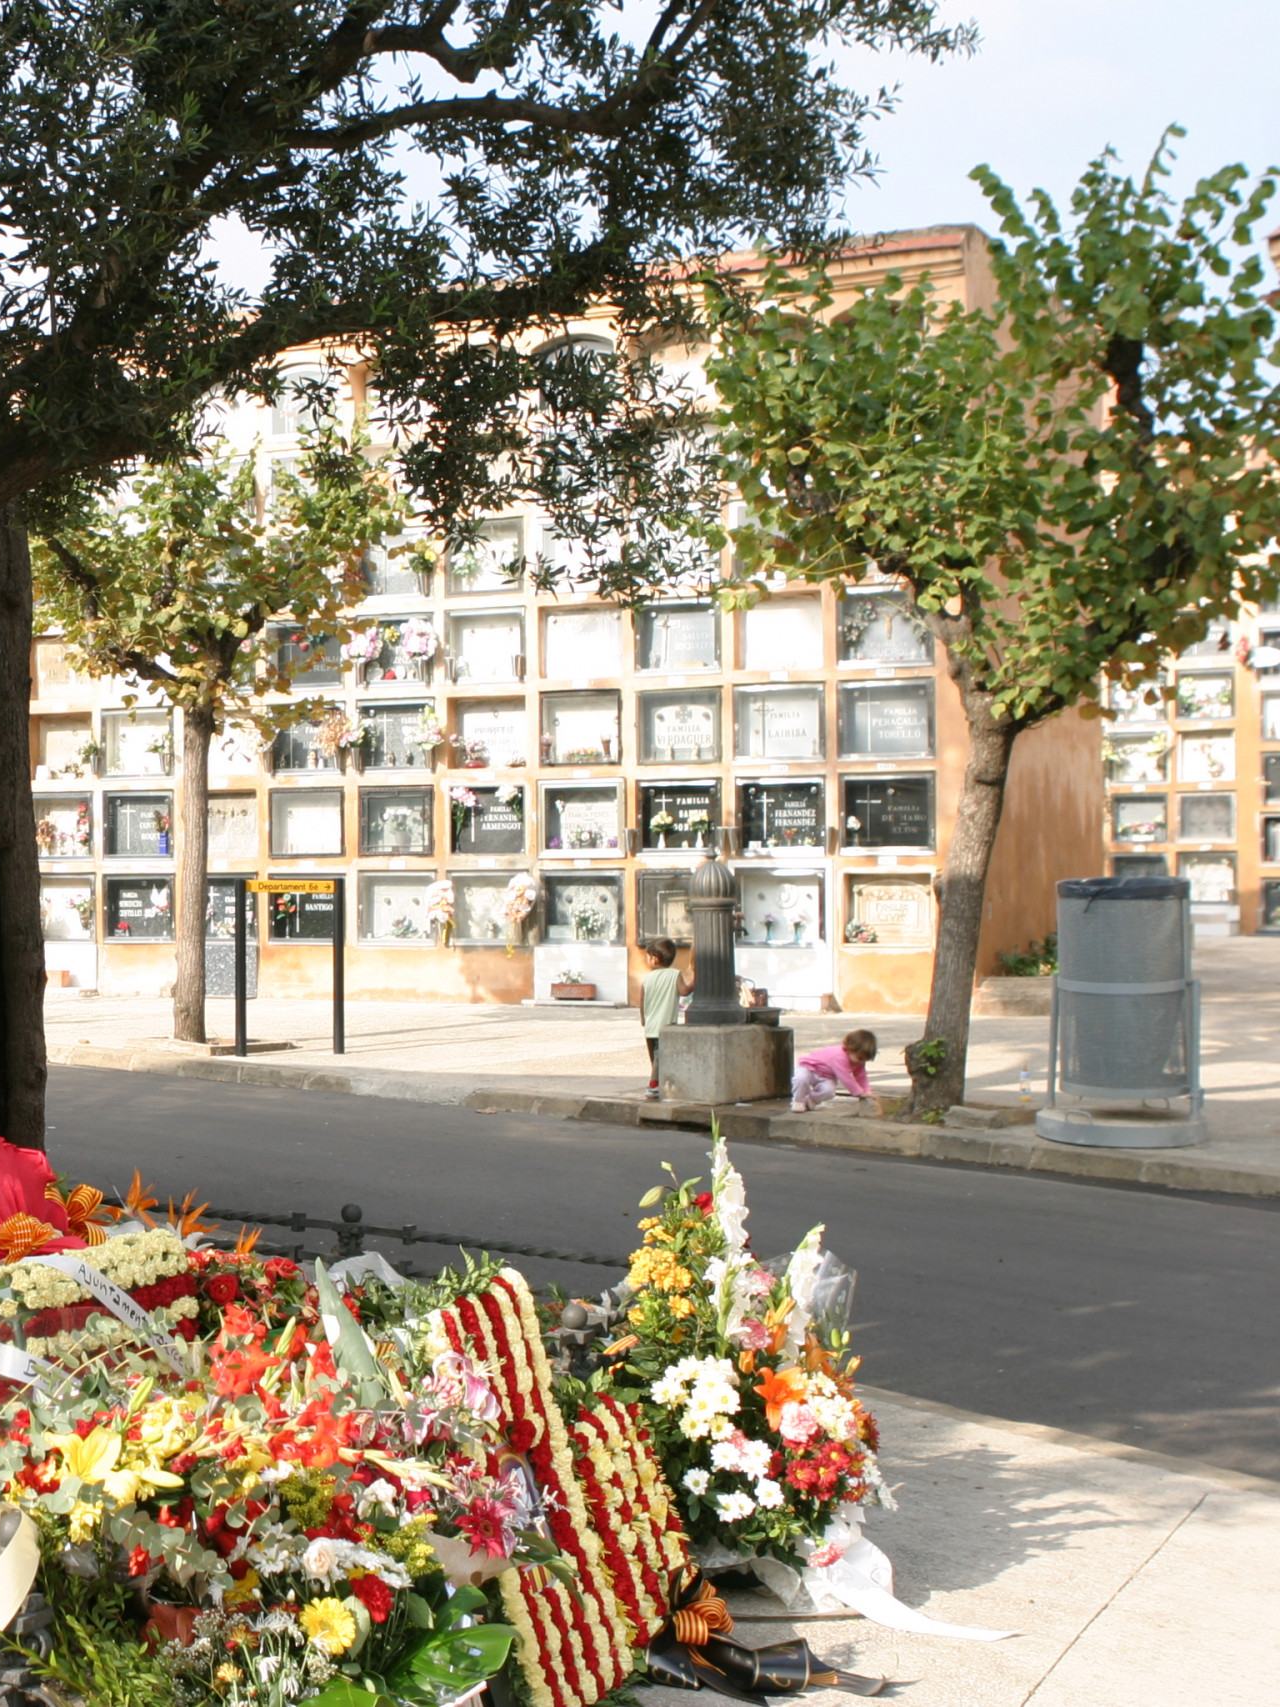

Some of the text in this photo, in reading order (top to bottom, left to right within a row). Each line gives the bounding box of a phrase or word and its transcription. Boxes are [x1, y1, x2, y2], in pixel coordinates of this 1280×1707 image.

[770, 711, 800, 719] FAMILIA
[883, 707, 917, 715] FAMILIA
[667, 724, 701, 733] FAMILIA
[676, 797, 710, 805] FAMILIA
[258, 881, 319, 893] Departament 6e
